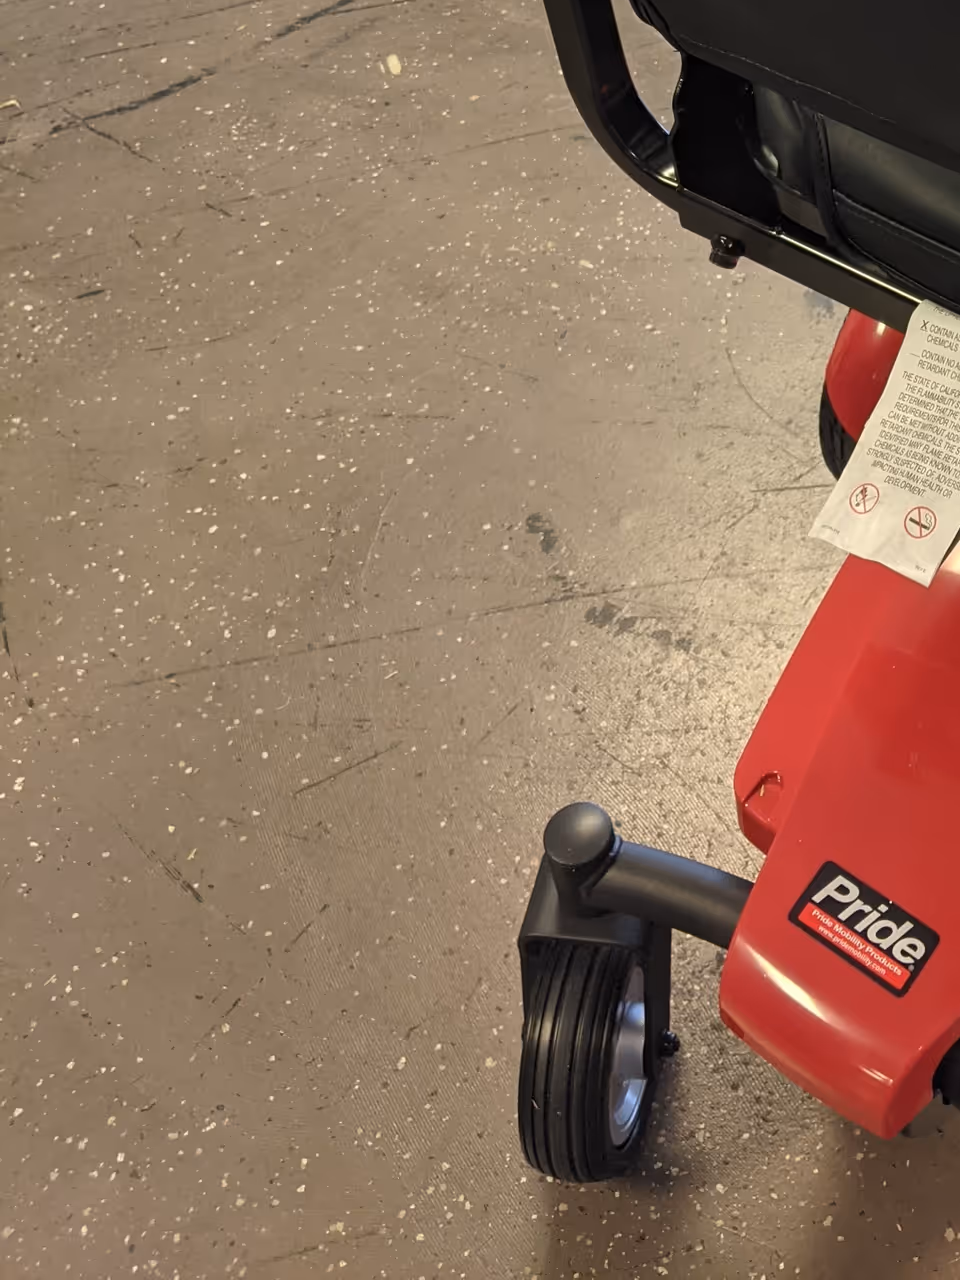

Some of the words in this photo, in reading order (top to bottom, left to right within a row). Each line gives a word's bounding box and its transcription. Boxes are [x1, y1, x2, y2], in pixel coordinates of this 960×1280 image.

[920, 319, 929, 329] X
[929, 323, 954, 339] CONTAIN
[926, 333, 959, 352] CHEMICALS
[917, 359, 950, 376] RETARDANT
[921, 349, 946, 364] CONTAIN
[945, 357, 955, 367] NO
[902, 371, 913, 381] THE
[913, 375, 930, 387] STATE
[930, 381, 940, 391] OF
[898, 392, 935, 411] DETERMINED
[934, 404, 948, 415] THAT
[947, 409, 959, 419] THE
[905, 383, 917, 393] THE
[916, 387, 955, 407] FLAMMABILITY
[887, 410, 901, 420] CAN
[900, 415, 910, 424] BE
[908, 418, 921, 428] MET
[920, 422, 946, 436] WITHOUT
[893, 401, 937, 423] REQUIREMENTS
[936, 416, 949, 426] FOR
[879, 419, 912, 436] RETARDANT
[943, 442, 956, 452] THE
[879, 430, 908, 445] IDENTIFIED
[907, 439, 923, 450] MANY
[921, 444, 943, 458] FLAME
[866, 447, 894, 462] STRONGLY
[892, 456, 927, 473] SUSPECTED
[874, 439, 905, 455] CHEMICALS
[904, 449, 912, 457] AS
[910, 451, 930, 463] BEING
[928, 459, 953, 473] KNOWN
[897, 469, 921, 483] HUMAN
[918, 478, 944, 493] HEALTH
[942, 488, 953, 498] OR
[811, 874, 926, 965] Pride
[812, 908, 833, 928] Pride
[833, 924, 866, 951] Mobility
[864, 944, 902, 977] Products
[818, 924, 887, 976] www.pridemobility.com
